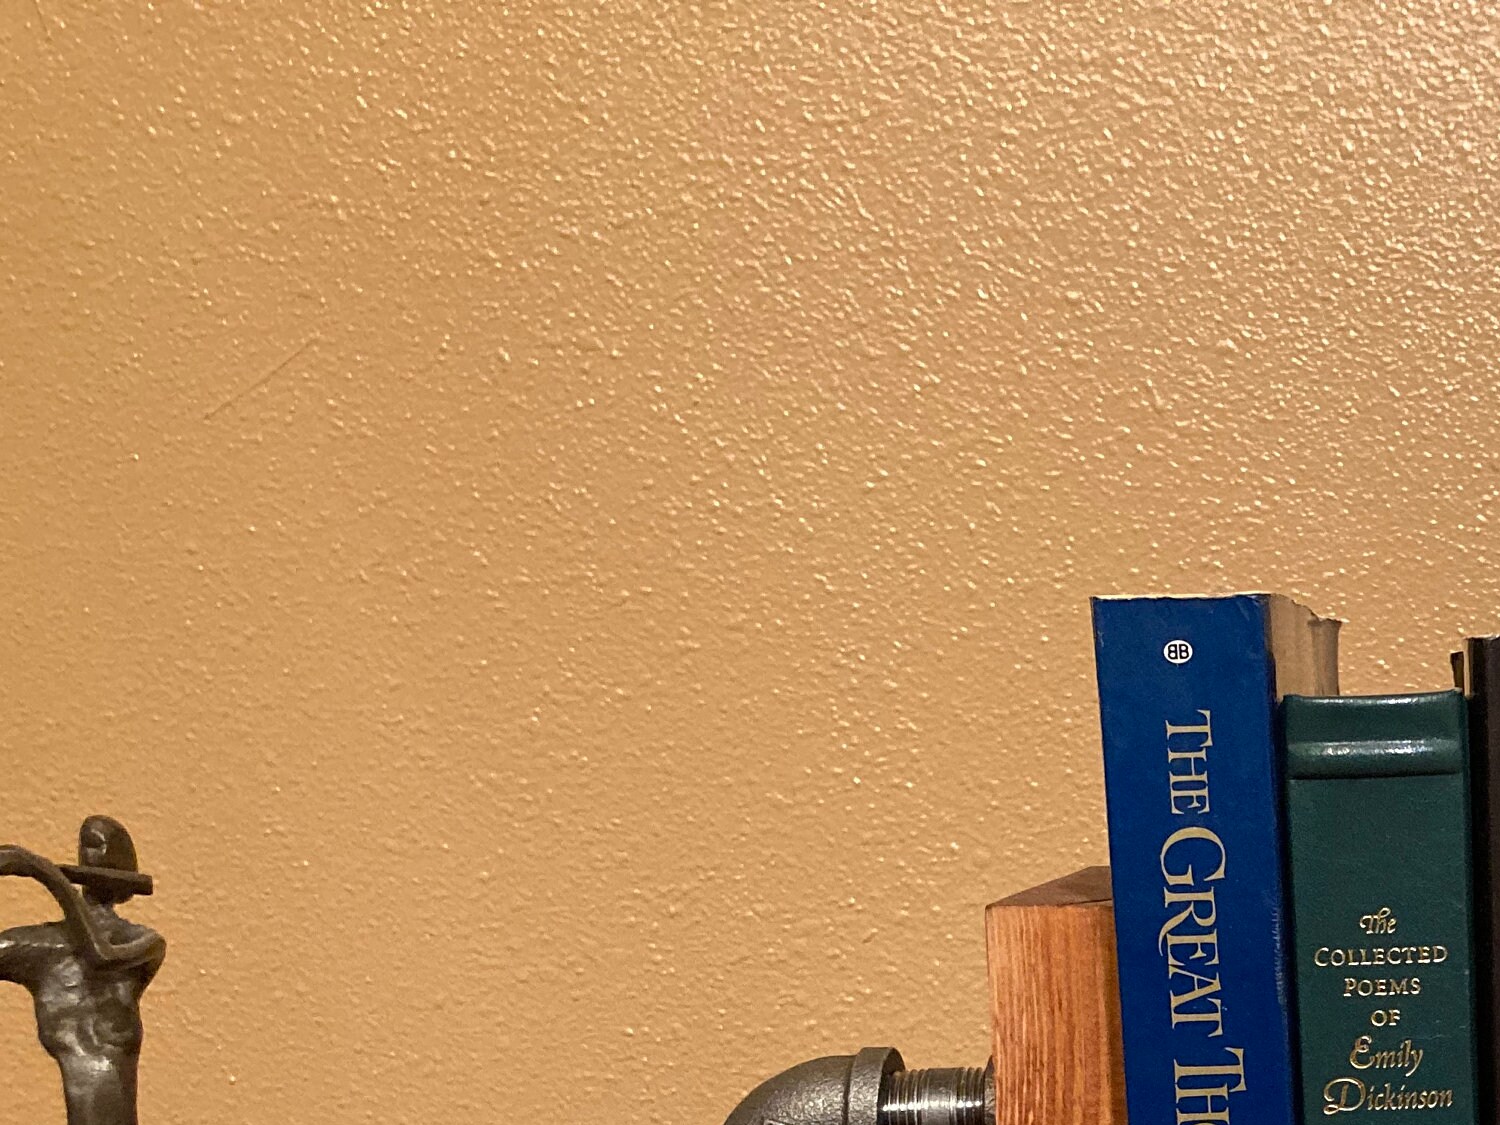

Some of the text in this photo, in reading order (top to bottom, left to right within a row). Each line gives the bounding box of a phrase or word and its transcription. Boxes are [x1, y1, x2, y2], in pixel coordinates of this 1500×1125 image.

[1165, 709, 1213, 815] THE
[1158, 826, 1227, 1038] GREAT
[1359, 907, 1397, 934] The
[1314, 945, 1448, 967] COLLECTED
[1343, 977, 1421, 997] POEMS
[1371, 1009, 1401, 1027] OF
[1350, 1035, 1424, 1078] Emily
[1322, 1077, 1453, 1115] Dickinson
